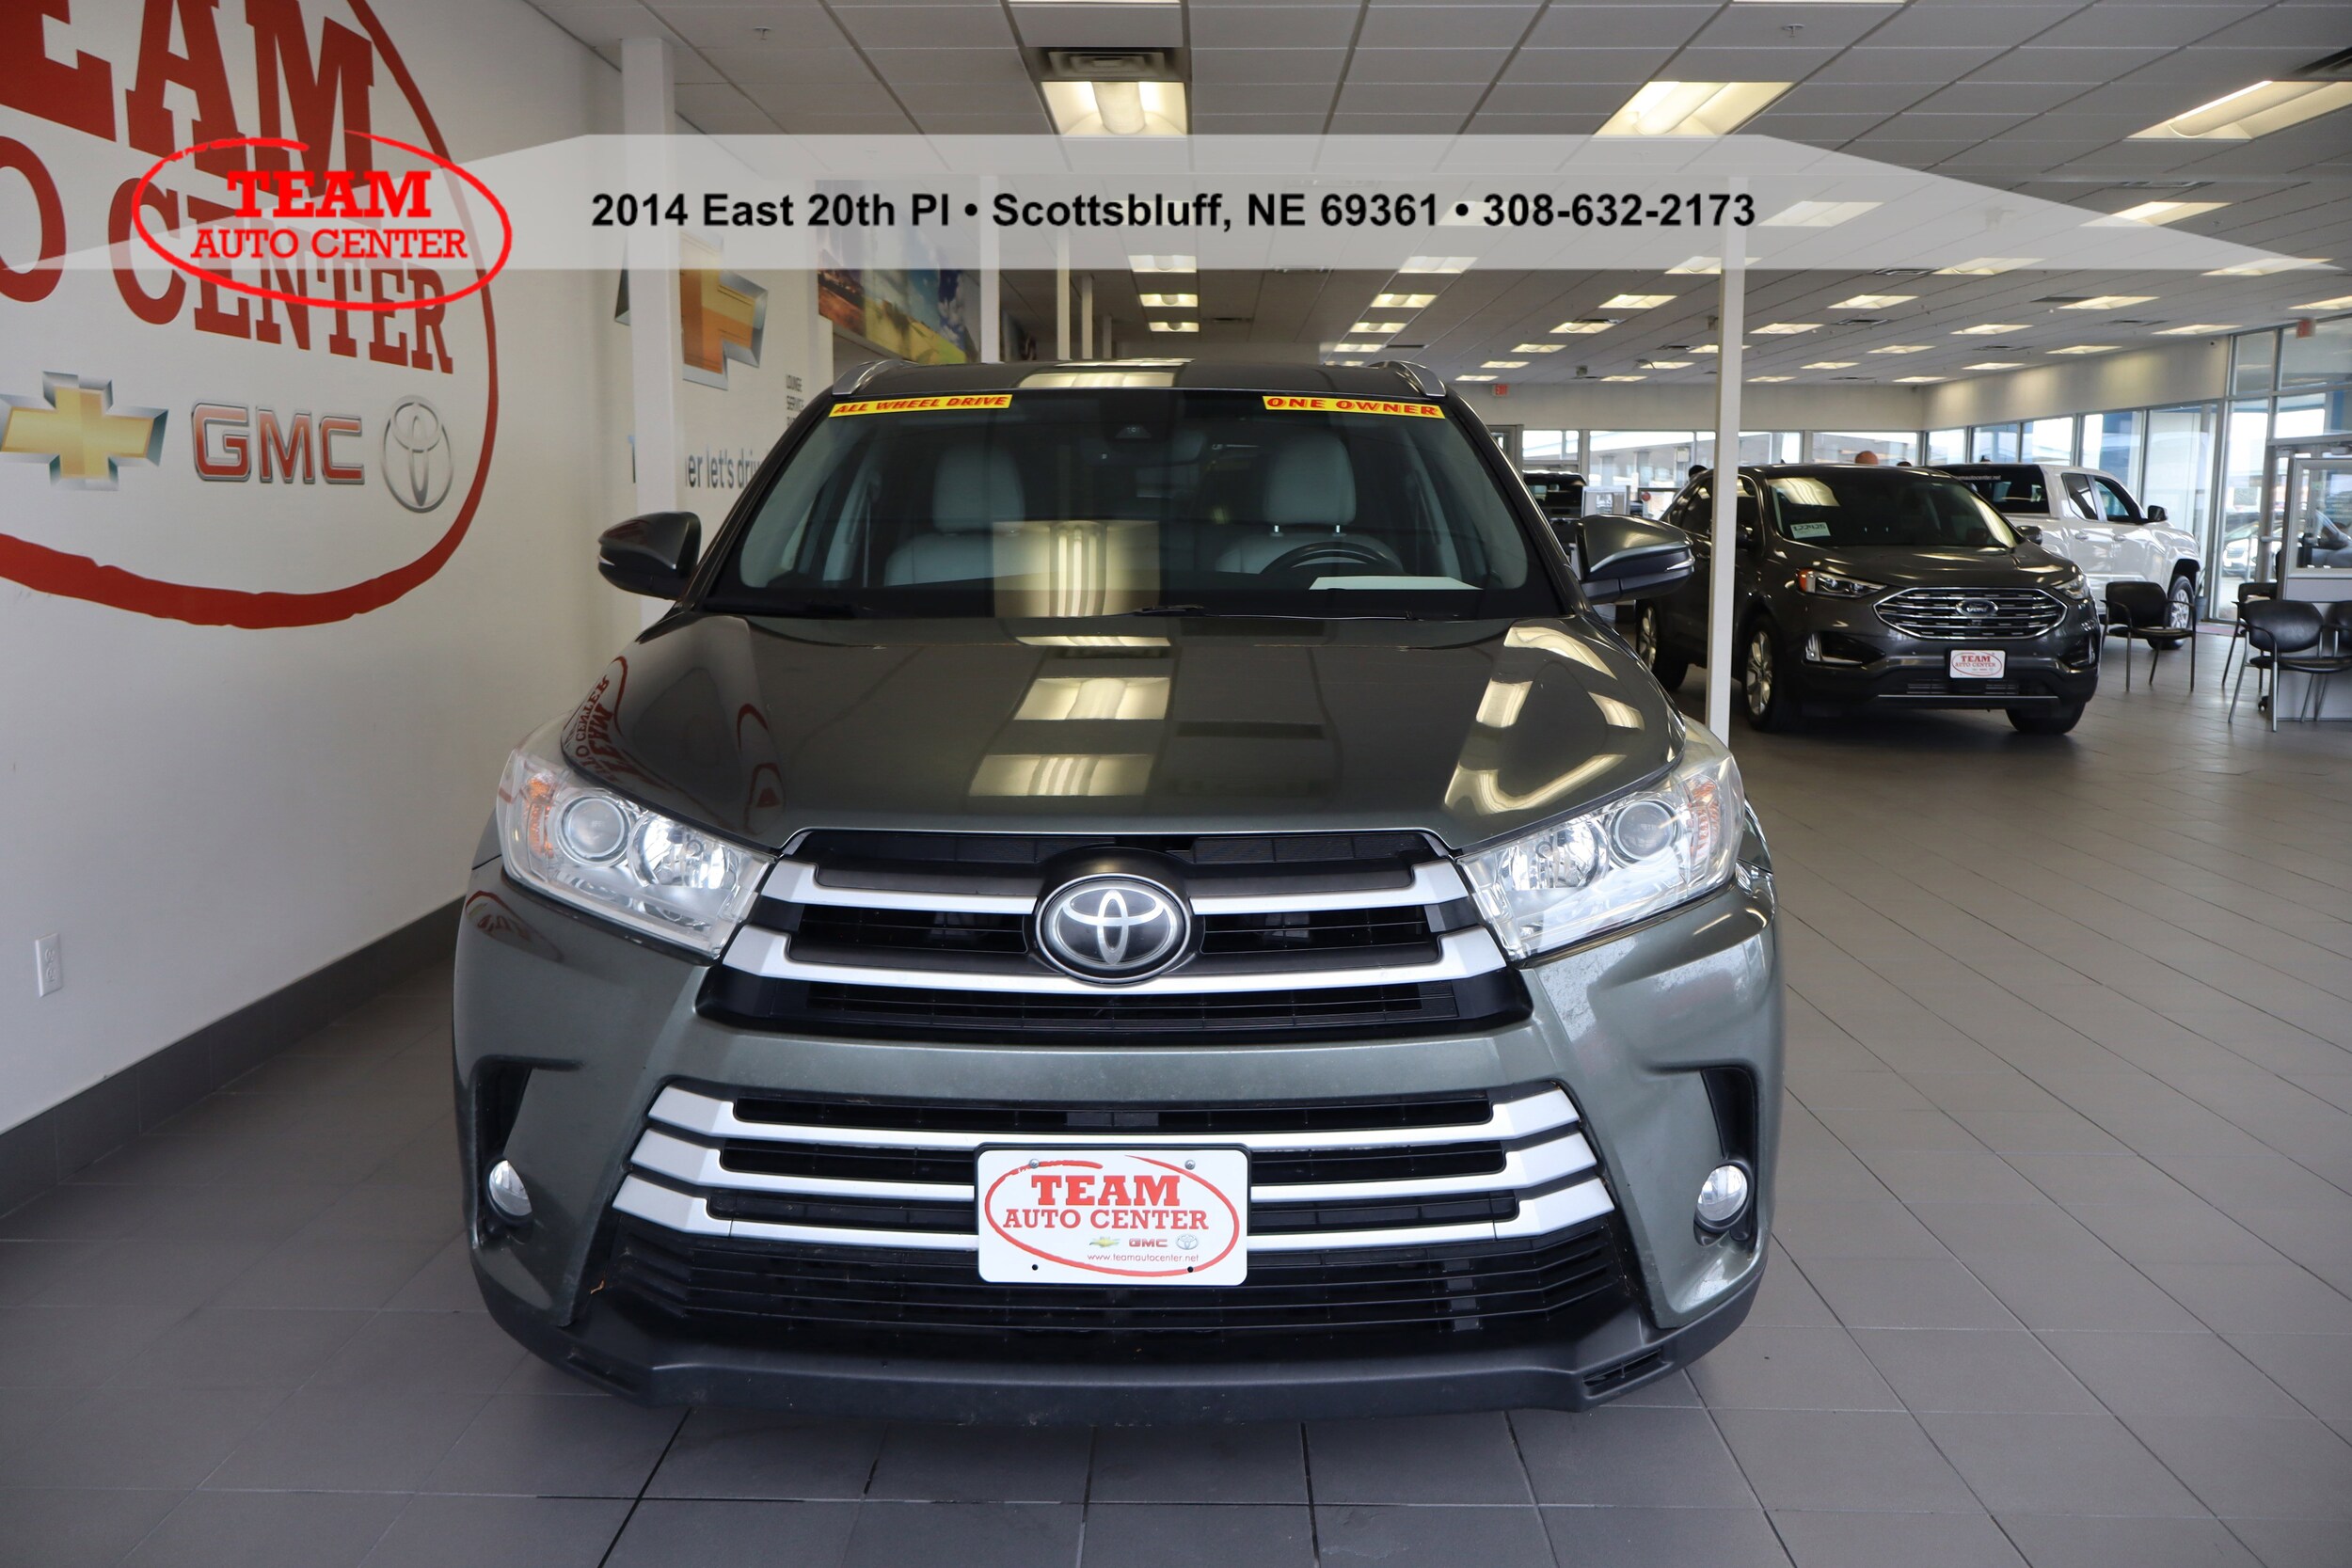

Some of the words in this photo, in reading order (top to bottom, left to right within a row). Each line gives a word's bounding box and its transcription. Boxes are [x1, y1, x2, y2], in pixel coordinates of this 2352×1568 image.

[108, 177, 453, 374] CENTER
[834, 403, 868, 414] ALL
[876, 399, 941, 410] WHEEL
[946, 396, 1009, 406] DRIVE
[1266, 397, 1327, 408] ONE
[1335, 400, 1439, 416] OWNER
[191, 399, 365, 484] GMC
[707, 448, 736, 489] let's
[1031, 1174, 1181, 1207] TEAM
[1002, 1208, 1082, 1228] AUTO
[1089, 1209, 1209, 1230] CENTER
[1128, 1237, 1168, 1248] GMC
[1087, 1252, 1200, 1263] www.teamautocenter.net
